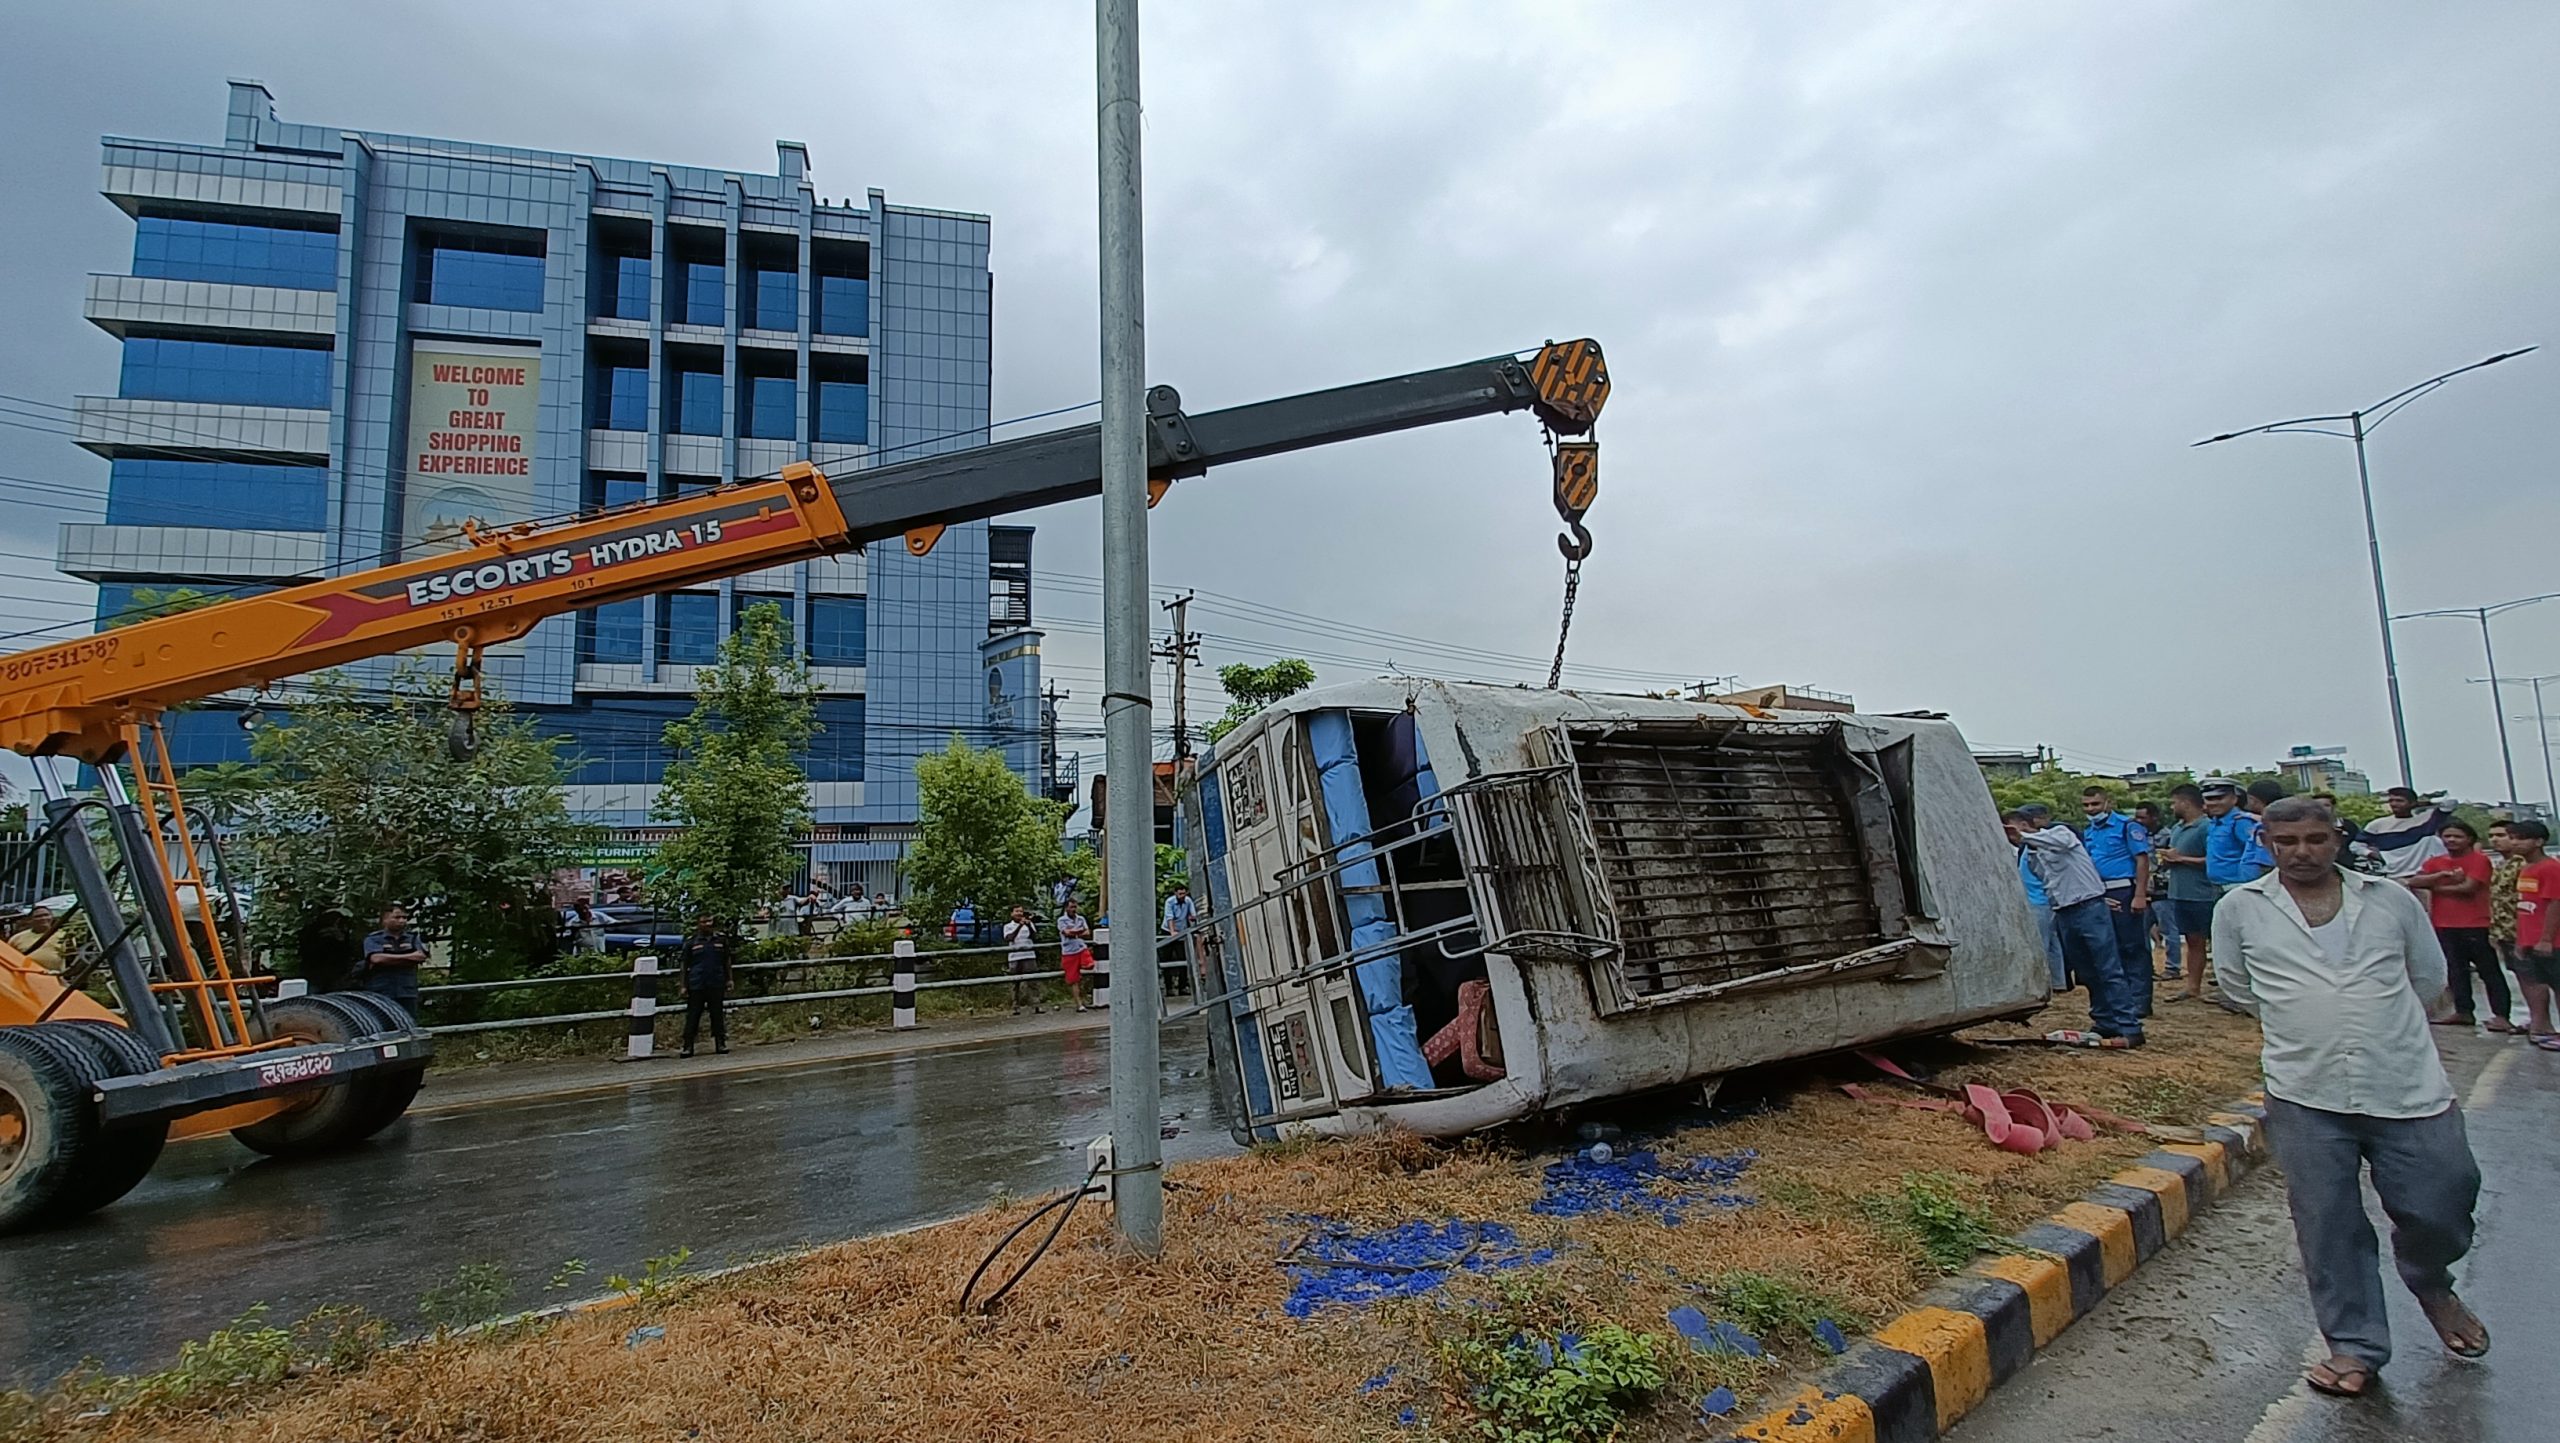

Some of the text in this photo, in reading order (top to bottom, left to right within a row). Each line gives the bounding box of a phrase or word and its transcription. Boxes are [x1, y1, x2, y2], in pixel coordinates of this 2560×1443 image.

[433, 364, 525, 386] WELCOME
[467, 388, 489, 406] TO
[448, 410, 506, 430] GREAT
[429, 432, 521, 453] SHOPPING
[418, 454, 529, 475] EXPERIENCE
[406, 519, 722, 606] ESCORTS HYDRA 15
[570, 577, 596, 590] 10 T
[440, 606, 465, 620] 15 T
[479, 595, 514, 611] 12.5T
[1269, 1026, 1292, 1098] 3660
